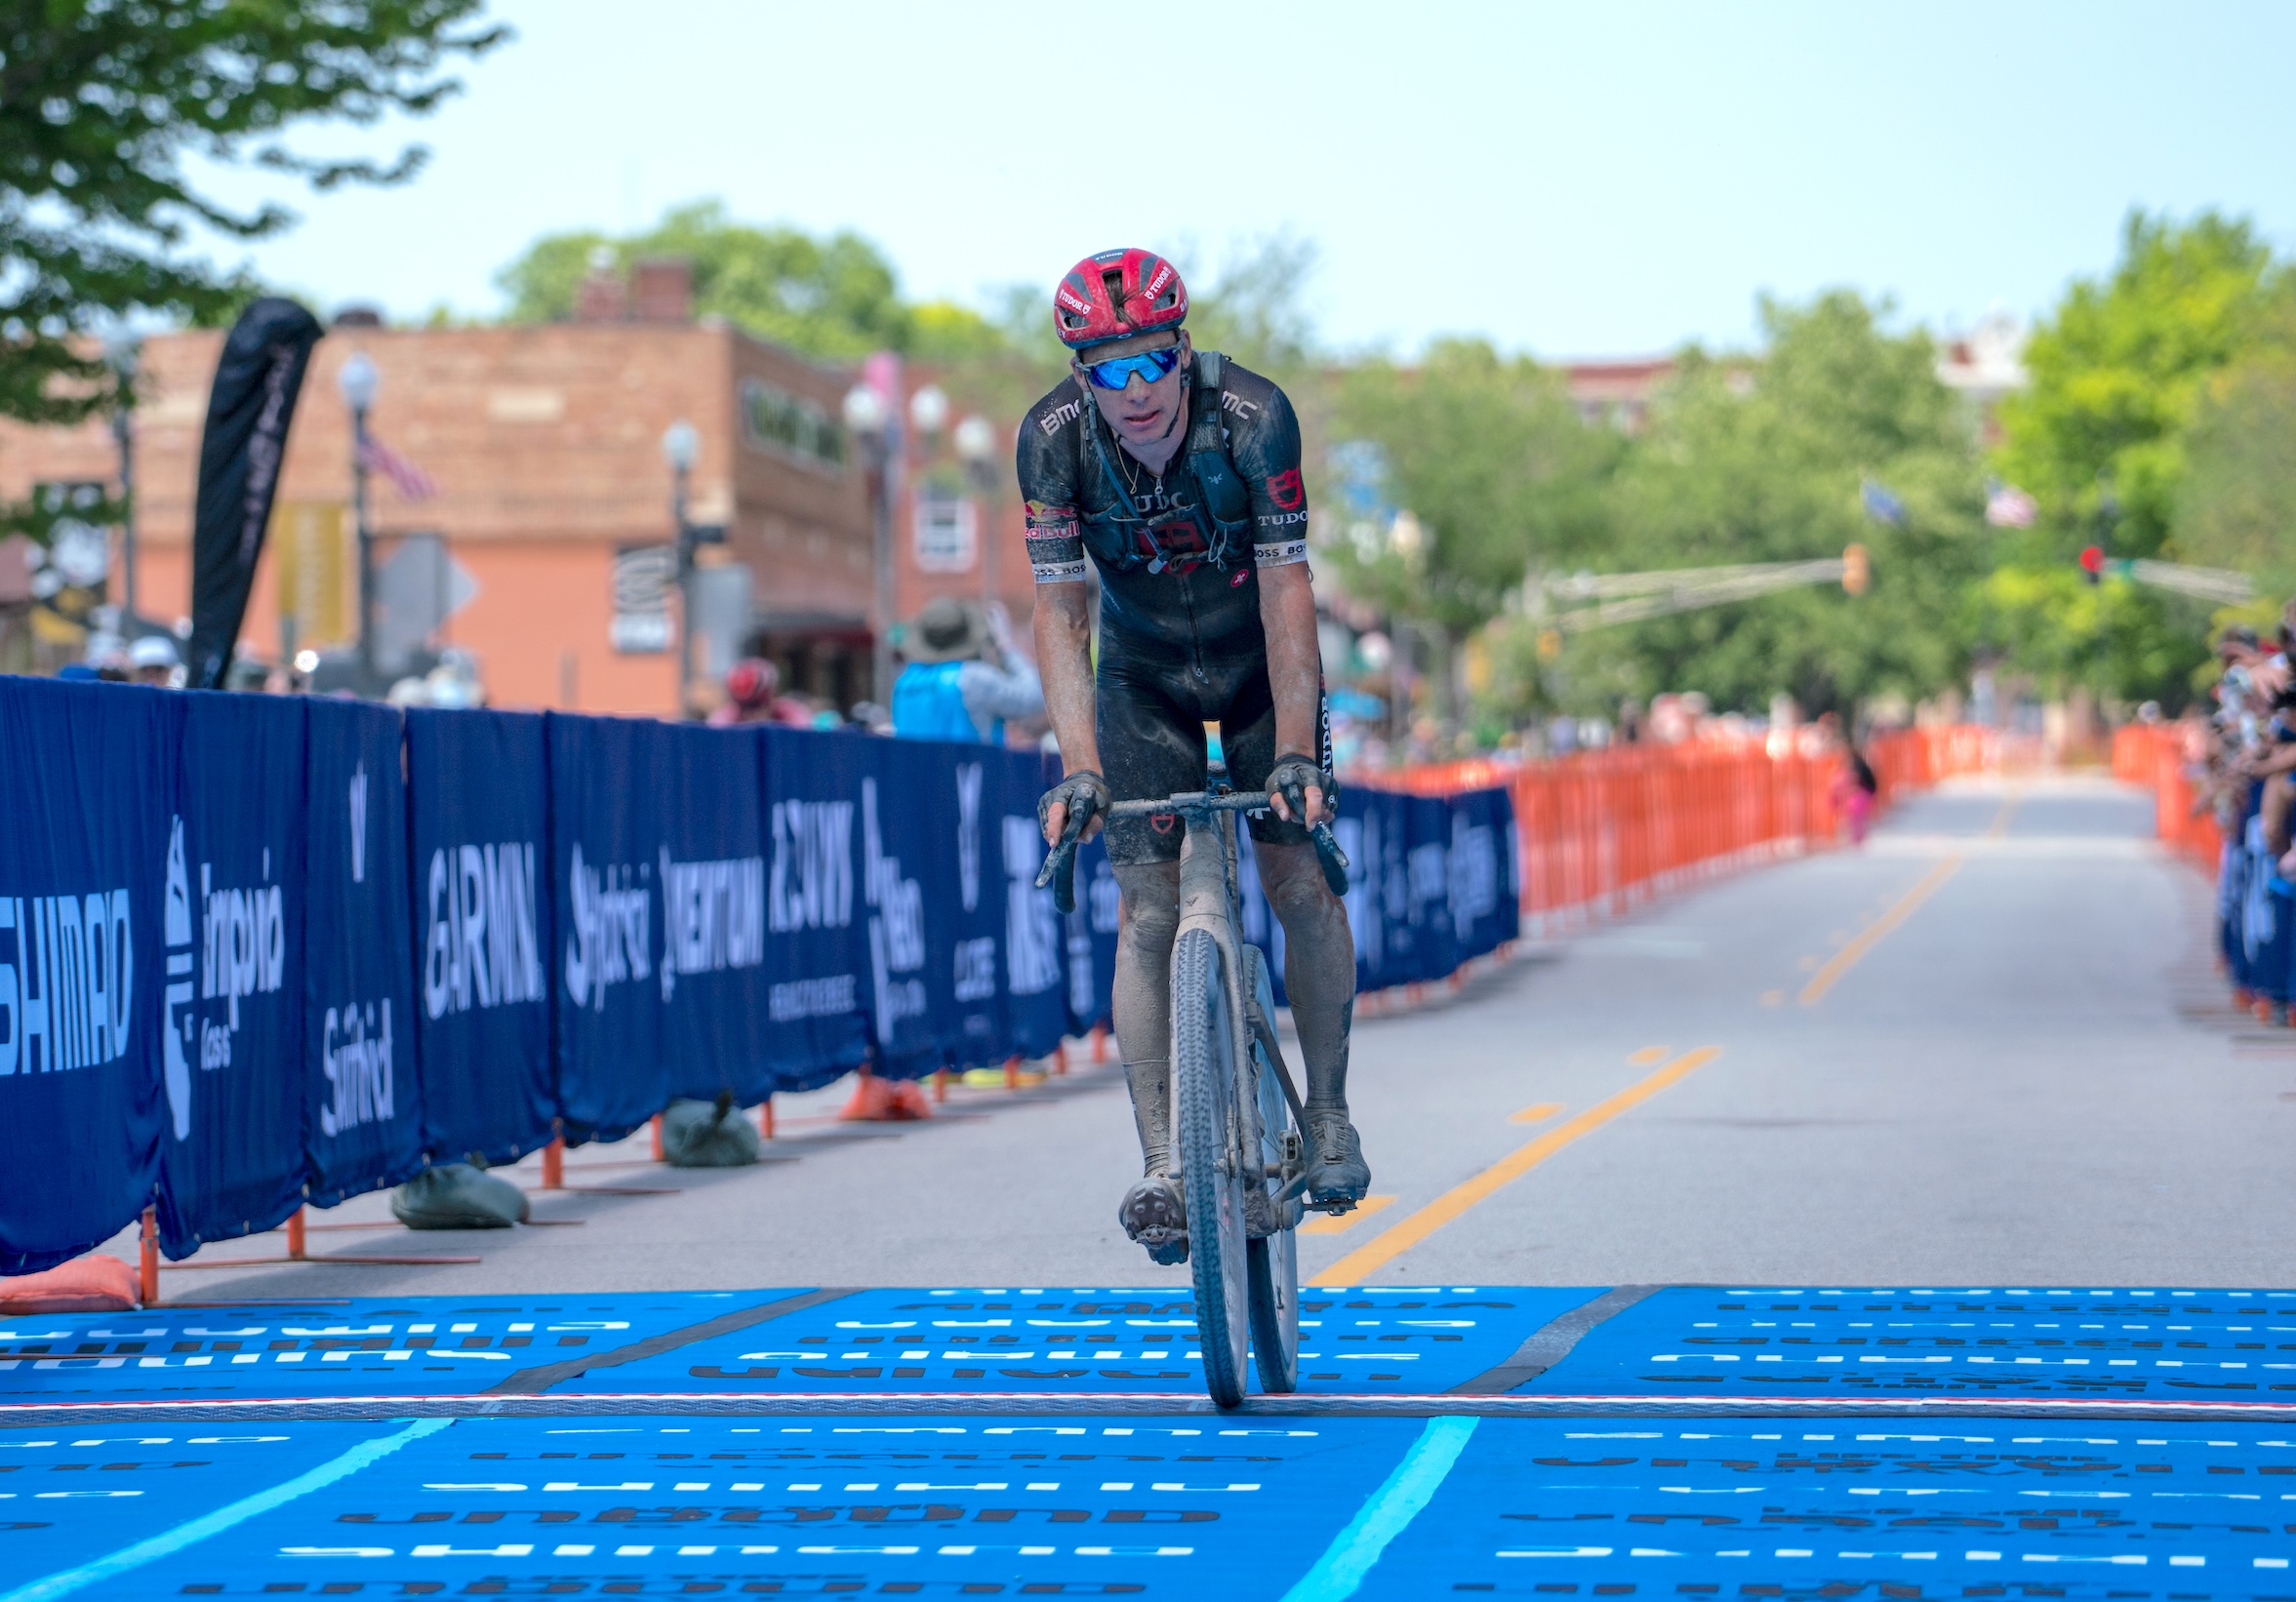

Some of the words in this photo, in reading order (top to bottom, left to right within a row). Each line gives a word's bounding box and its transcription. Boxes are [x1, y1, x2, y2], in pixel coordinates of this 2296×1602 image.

[1151, 266, 1170, 293] TUDOR
[1061, 292, 1083, 310] TUDOR
[1254, 549, 1279, 558] OSS
